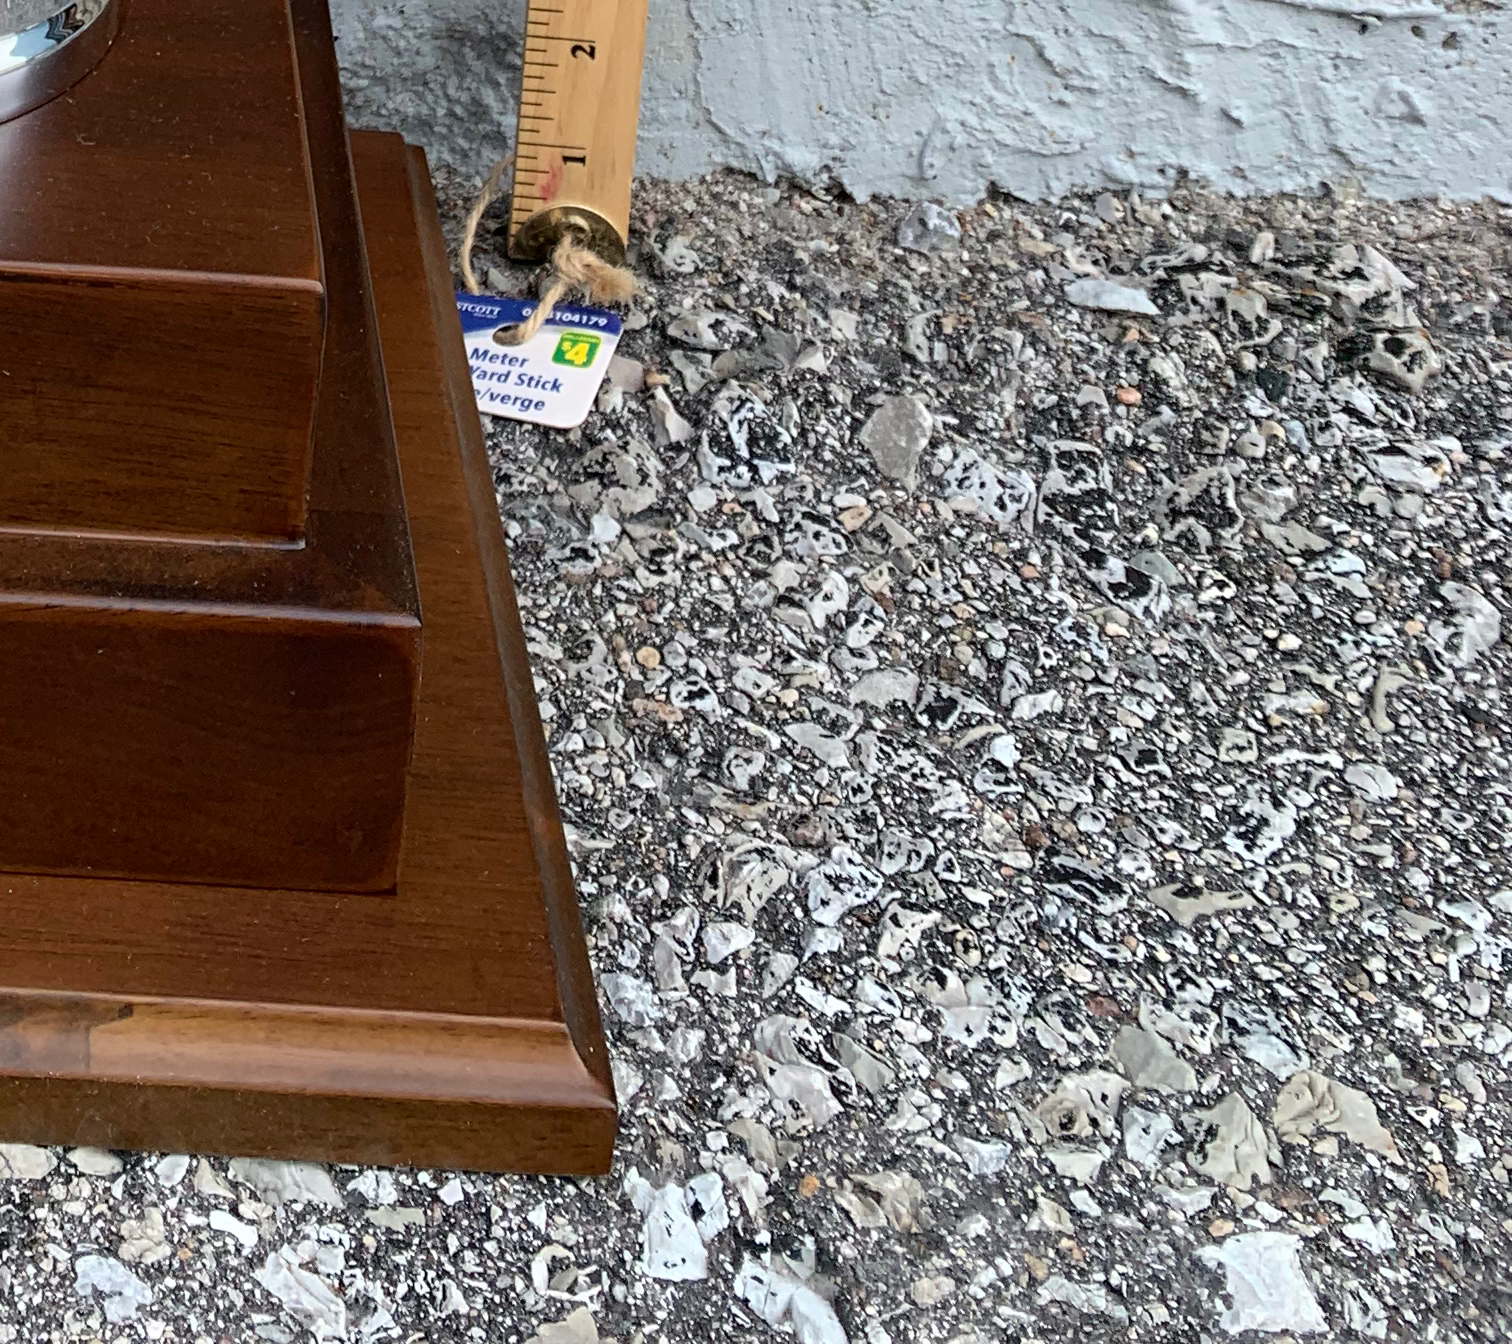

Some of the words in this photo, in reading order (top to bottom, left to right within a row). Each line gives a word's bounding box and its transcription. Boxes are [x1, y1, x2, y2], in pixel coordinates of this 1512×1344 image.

[571, 44, 596, 61] 2
[562, 155, 587, 167] 1
[469, 347, 529, 368] Meter
[562, 341, 590, 365] $4
[469, 365, 512, 384] Yard
[514, 372, 564, 393] Stick
